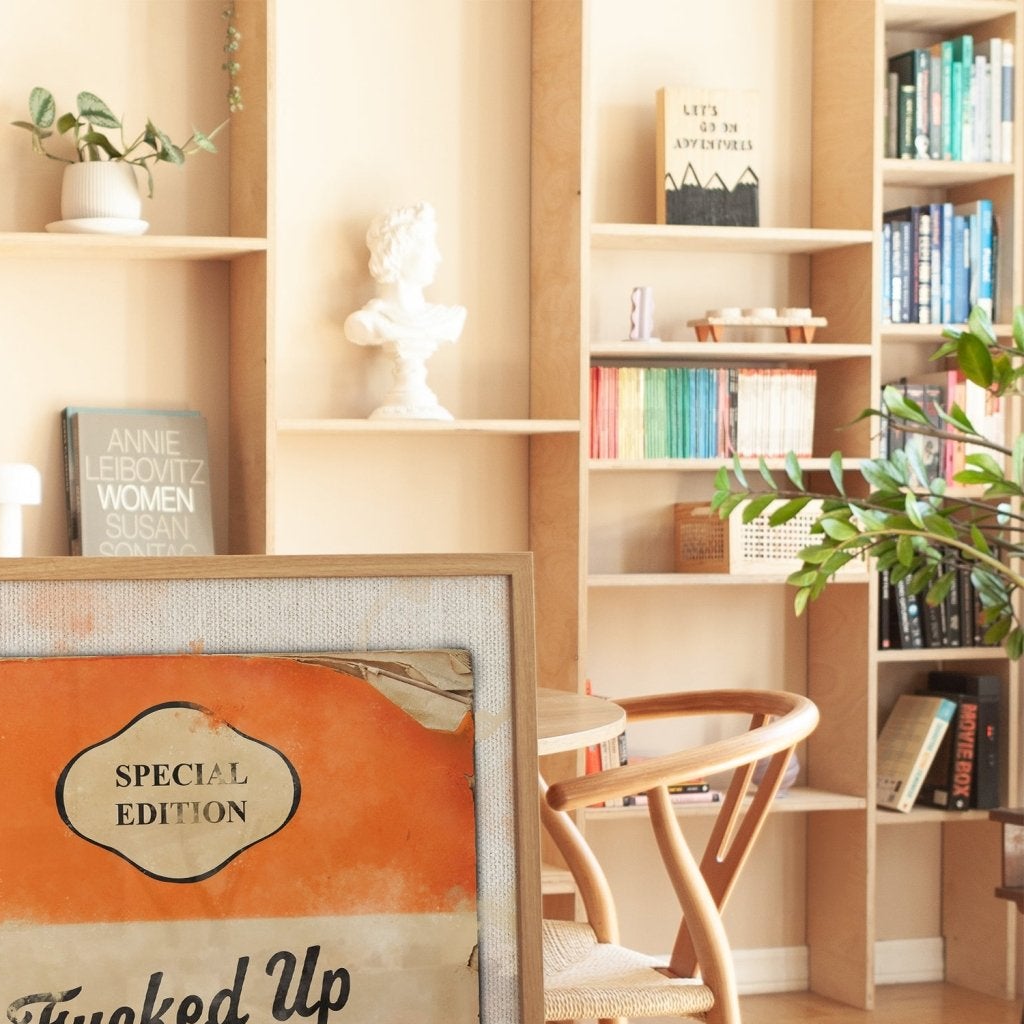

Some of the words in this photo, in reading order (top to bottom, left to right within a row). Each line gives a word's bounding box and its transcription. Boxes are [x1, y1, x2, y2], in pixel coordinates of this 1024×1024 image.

[683, 104, 718, 117] LET'S
[699, 121, 716, 133] GO
[722, 122, 738, 133] ON
[674, 138, 753, 151] ADVENTURES
[107, 428, 181, 456] ANNIE
[85, 455, 205, 485] LEIBOVITZ
[97, 484, 195, 513] WOMEN
[106, 512, 189, 540] SUSAN
[956, 703, 978, 760] MOVIE
[115, 762, 248, 788] SPECIAL
[952, 761, 973, 797] BOX
[115, 800, 247, 826] EDITION
